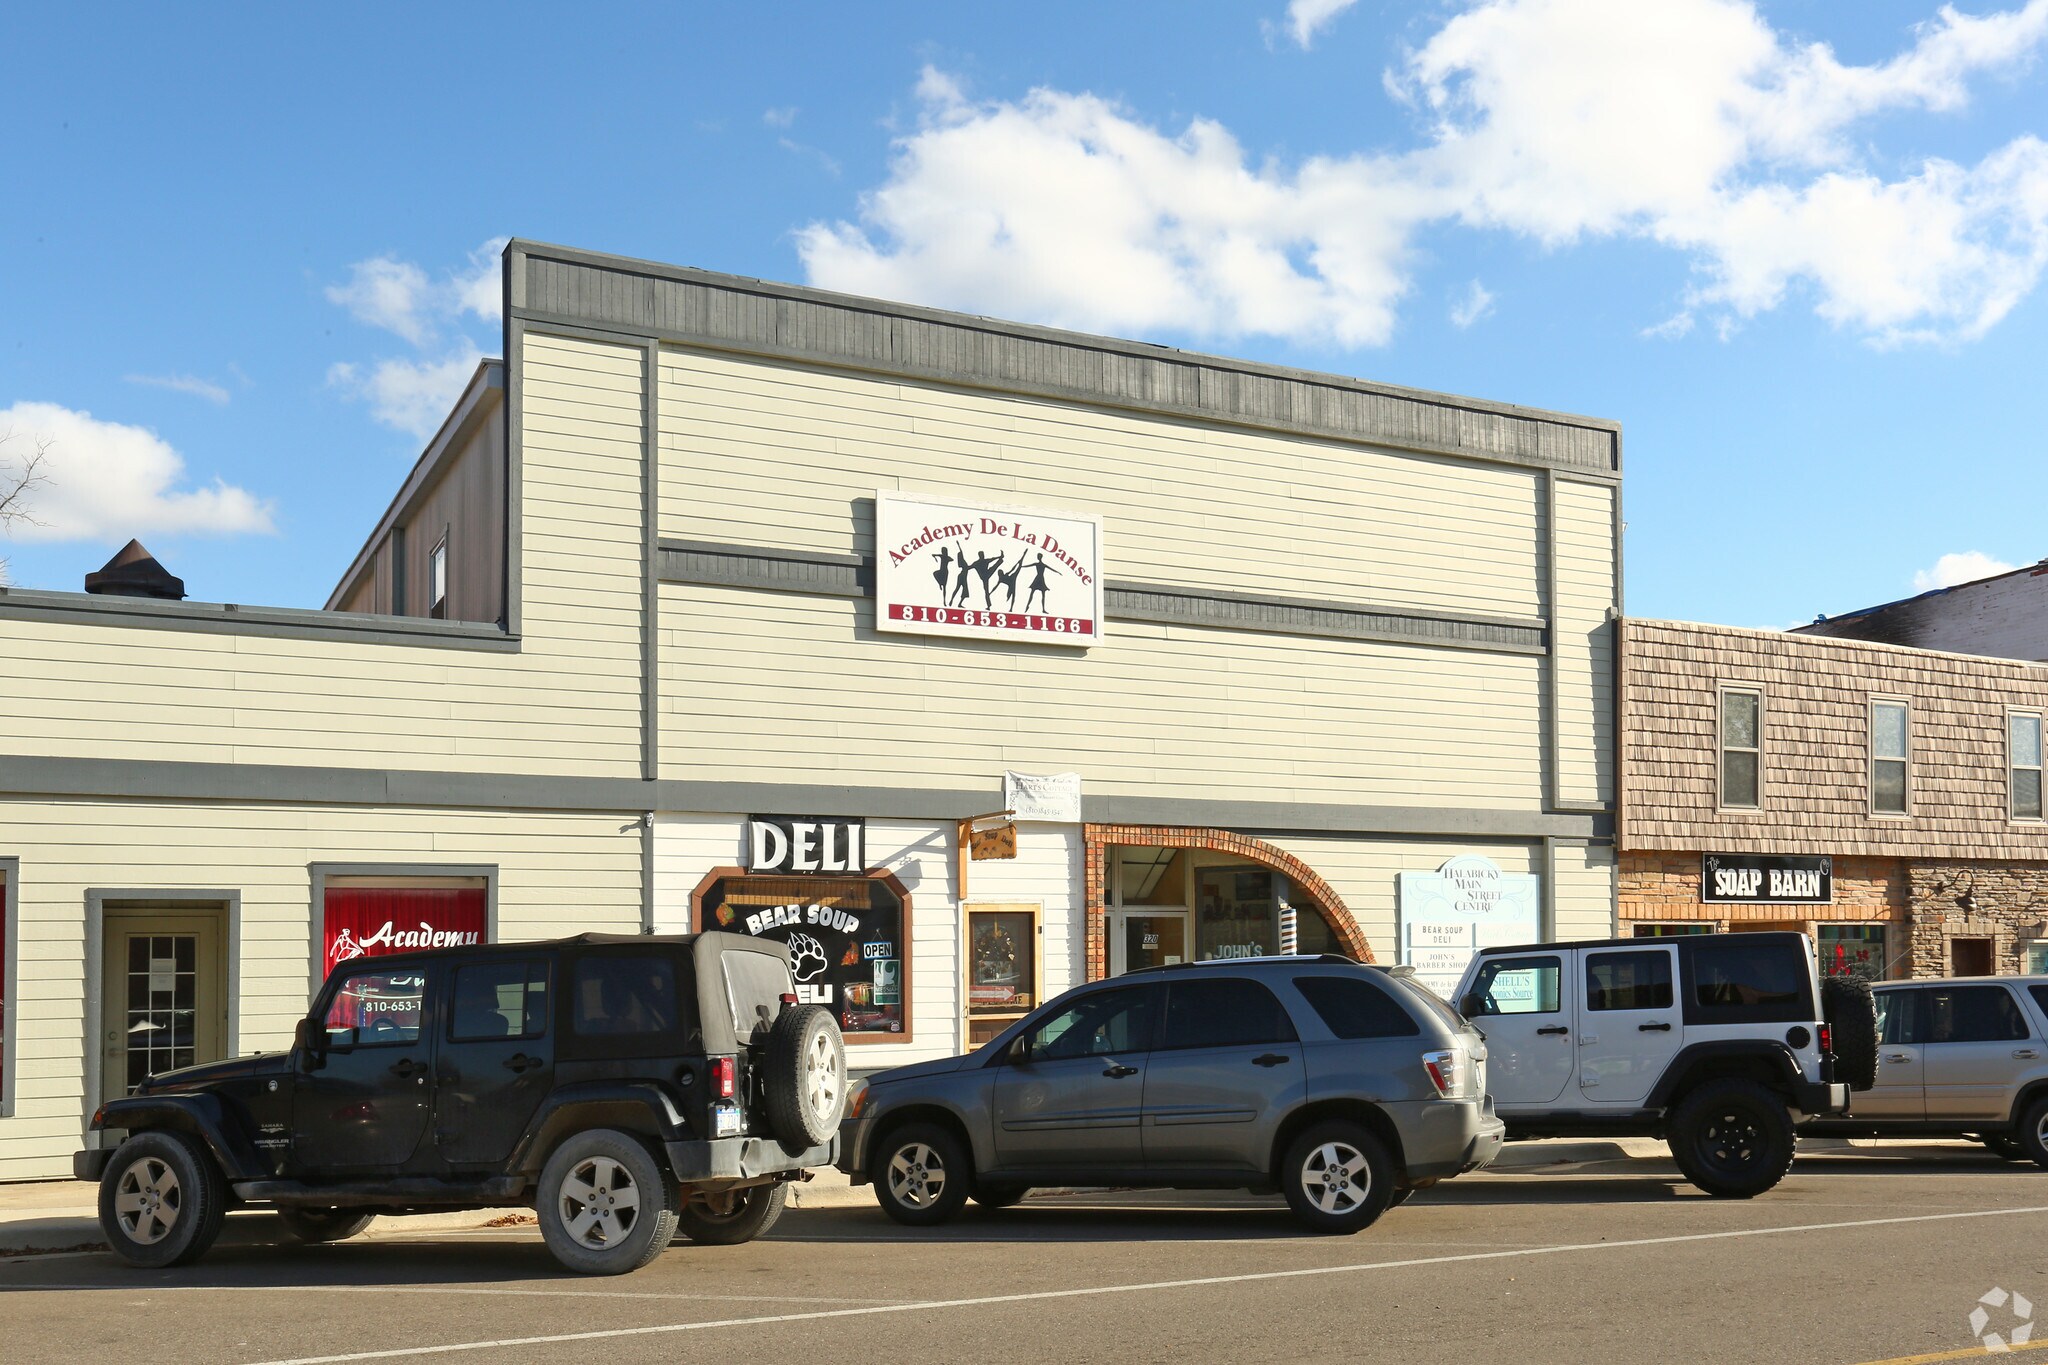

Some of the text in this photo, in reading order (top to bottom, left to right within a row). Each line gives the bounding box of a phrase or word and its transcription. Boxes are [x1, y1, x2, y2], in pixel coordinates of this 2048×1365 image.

[888, 518, 1092, 586] Academy De La Danse
[902, 605, 1081, 634] 810-653-1166
[751, 821, 861, 872] DELI
[1715, 868, 1821, 897] SOAP BARN
[745, 904, 860, 936] BEAR SOUP
[1422, 925, 1464, 934] BEAR SOUP
[1143, 935, 1158, 943] 320
[1433, 935, 1452, 944] DELI
[865, 944, 891, 957] OPEN
[1213, 941, 1263, 959] JOHN'S
[1429, 953, 1455, 961] JOHN'S
[1416, 961, 1468, 970] BARBER SHOP
[1494, 976, 1530, 986] SHELL'S
[794, 984, 833, 1004] ELI
[365, 1000, 422, 1012] 810-653-1
